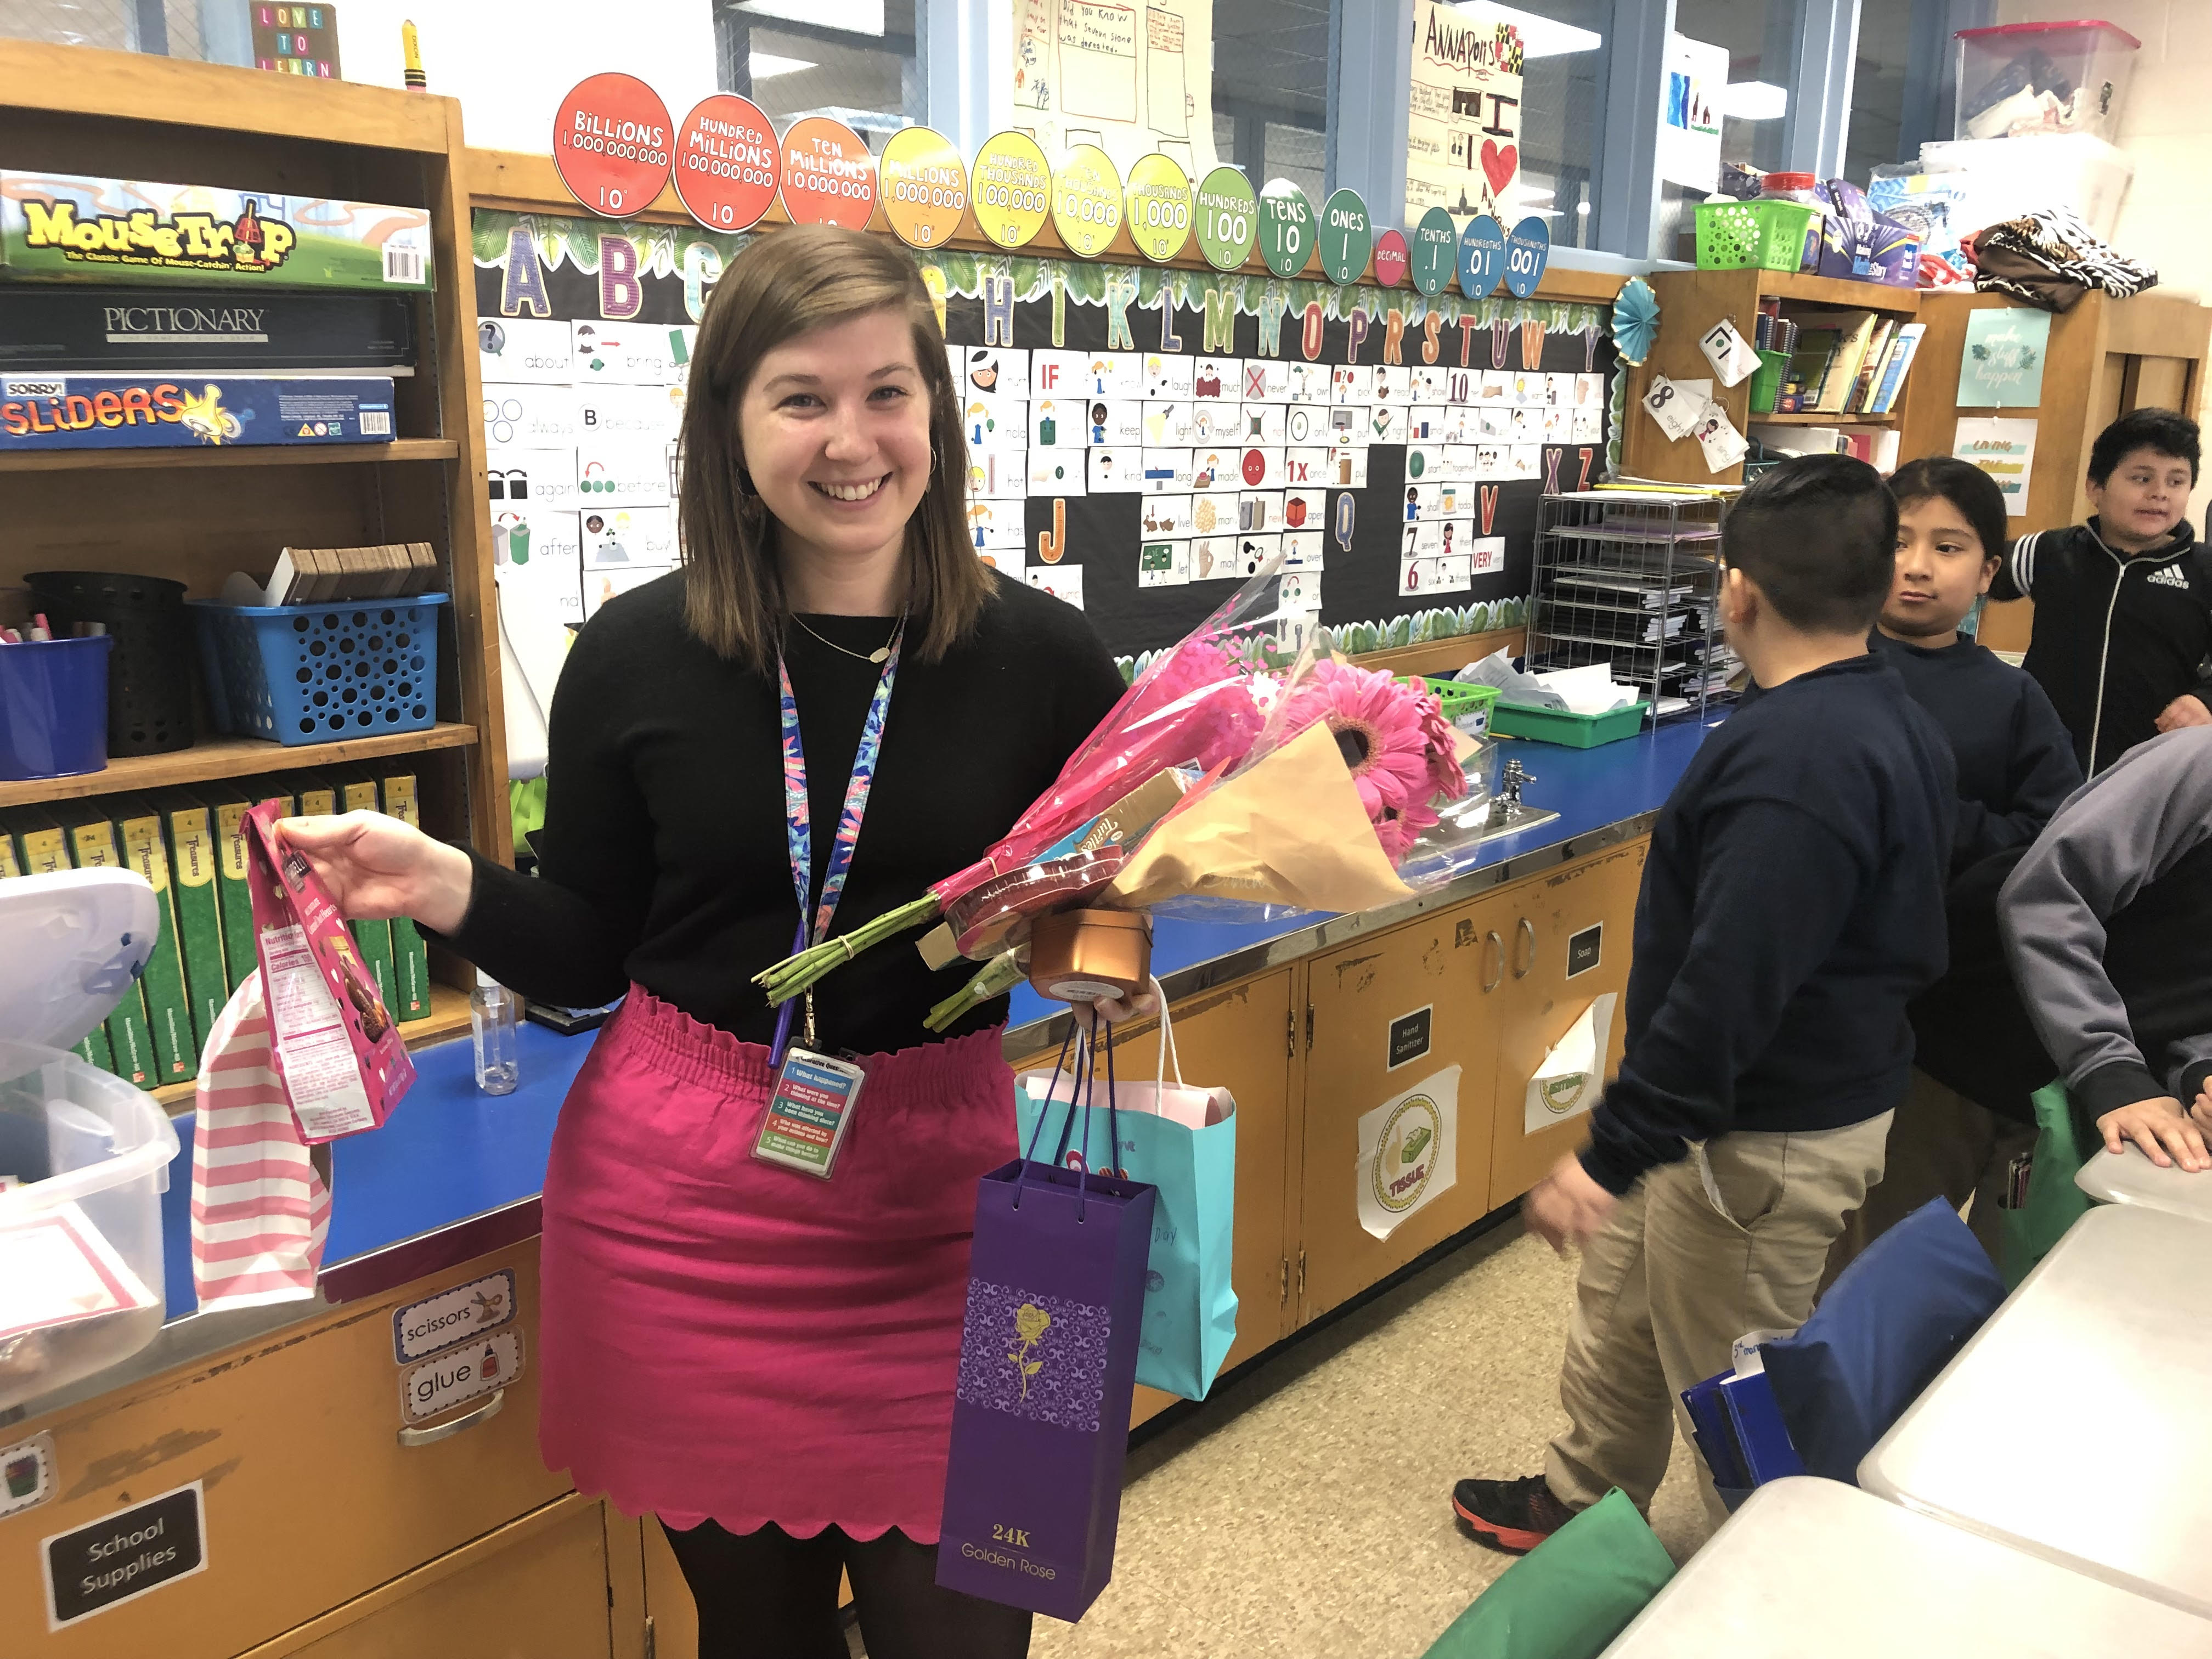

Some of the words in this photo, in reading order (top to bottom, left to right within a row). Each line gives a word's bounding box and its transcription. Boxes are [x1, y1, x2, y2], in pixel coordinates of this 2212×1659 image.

[262, 8, 320, 26] LOVE
[280, 35, 307, 51] TO
[1482, 92, 1518, 138] I
[563, 129, 668, 167] 1,000,000,000
[681, 151, 774, 188] 100,000,000
[979, 165, 1047, 190] THOUSANDS
[787, 169, 871, 201] 10,000,000
[884, 178, 965, 210] 1,000,000
[1132, 180, 1188, 201] THOUSANDS
[978, 182, 1046, 213] 100,000
[1199, 191, 1255, 216] HUNDREDS
[1057, 190, 1118, 228] 10,000
[1134, 198, 1188, 230] 1,000
[1206, 209, 1248, 245] 100
[1277, 223, 1300, 254] 10
[1342, 233, 1348, 261] 1
[1463, 236, 1502, 251] HUNDREDTHS
[1509, 235, 1547, 252] THOUSANDTHS
[66, 251, 83, 261] The
[86, 252, 120, 262] Classic
[122, 255, 149, 264] Game
[236, 263, 264, 272] Action!
[502, 229, 550, 315] A
[599, 235, 640, 317] B
[684, 241, 724, 324] C
[984, 275, 1014, 347] H
[1052, 278, 1065, 347] I
[1108, 282, 1135, 349] K
[1160, 285, 1182, 352] L
[1203, 289, 1235, 354] M
[1258, 296, 1282, 357] N
[1302, 301, 1324, 361] O
[1347, 307, 1368, 364] P
[1383, 308, 1404, 365] R
[1421, 310, 1441, 365] S
[1459, 314, 1477, 368] T
[1492, 317, 1510, 369] U
[1521, 319, 1547, 370] W
[1584, 325, 1601, 372] Y
[104, 307, 264, 332] PICTIONARY
[1984, 325, 2024, 347] make
[525, 353, 569, 369] about
[628, 356, 662, 375] bring
[1988, 345, 2020, 368] stuff
[1042, 364, 1059, 390] IF
[1172, 377, 1193, 396] laugh
[1222, 380, 1241, 392] much
[1975, 364, 2023, 390] happen
[8, 384, 63, 394] SORRY!
[1267, 384, 1287, 393] never
[1357, 381, 1370, 399] pick
[1450, 373, 1469, 402] 10
[1650, 385, 1674, 408] 8
[584, 409, 597, 426] B
[606, 416, 664, 430] because
[1666, 414, 1685, 435] eight
[1120, 421, 1141, 441] keep
[1176, 422, 1192, 441] light
[1215, 423, 1240, 439] myself
[1717, 445, 1730, 463] sing
[1973, 439, 2013, 453] LIVING
[1124, 471, 1142, 481] kind
[1176, 469, 1192, 487] long
[1218, 469, 1239, 481] made
[1310, 470, 1327, 478] once
[1453, 465, 1475, 476] together
[1544, 448, 1562, 494] X
[1577, 447, 1593, 493] Z
[618, 476, 667, 492] before
[1008, 474, 1023, 487] hot
[535, 483, 575, 502] again
[1308, 512, 1324, 524] open
[1480, 485, 1499, 535] V
[1008, 522, 1023, 536] has
[1178, 514, 1190, 528] live
[1335, 492, 1356, 552] Q
[1039, 498, 1066, 564] J
[540, 538, 578, 555] after
[1406, 527, 1418, 556] 7
[1421, 541, 1438, 550] seven
[1220, 558, 1235, 572] may
[1306, 553, 1322, 562] over
[1473, 551, 1493, 569] VERY
[1178, 563, 1188, 574] let
[1408, 560, 1420, 590] 6
[2147, 574, 2190, 590] adidas
[1081, 817, 1118, 853] Turtles
[138, 839, 154, 884] Treasure
[186, 834, 200, 877] Treasures
[230, 834, 243, 870] Treasures
[1576, 946, 1592, 962] Soap
[270, 959, 299, 971] Calories
[1402, 1024, 1419, 1039] Hand
[1396, 1036, 1424, 1055] Sanitizer
[792, 1084, 806, 1093] What
[796, 1069, 812, 1079] What
[814, 1074, 847, 1089] happened?
[791, 1090, 810, 1101] thinking
[787, 1101, 800, 1110] What
[802, 1106, 813, 1114] have
[798, 1111, 818, 1122] thinking
[802, 1124, 820, 1135] affected
[773, 1135, 787, 1144] What
[1389, 1163, 1425, 1198] TISSUE
[1154, 1227, 1177, 1246] Day
[407, 1302, 471, 1342] scissors
[416, 1361, 472, 1402] glue
[88, 1516, 164, 1562] School
[992, 1523, 1031, 1548] 24K
[80, 1543, 176, 1595] Supplies
[962, 1543, 1016, 1571] Golden
[1020, 1558, 1056, 1581] Rose
